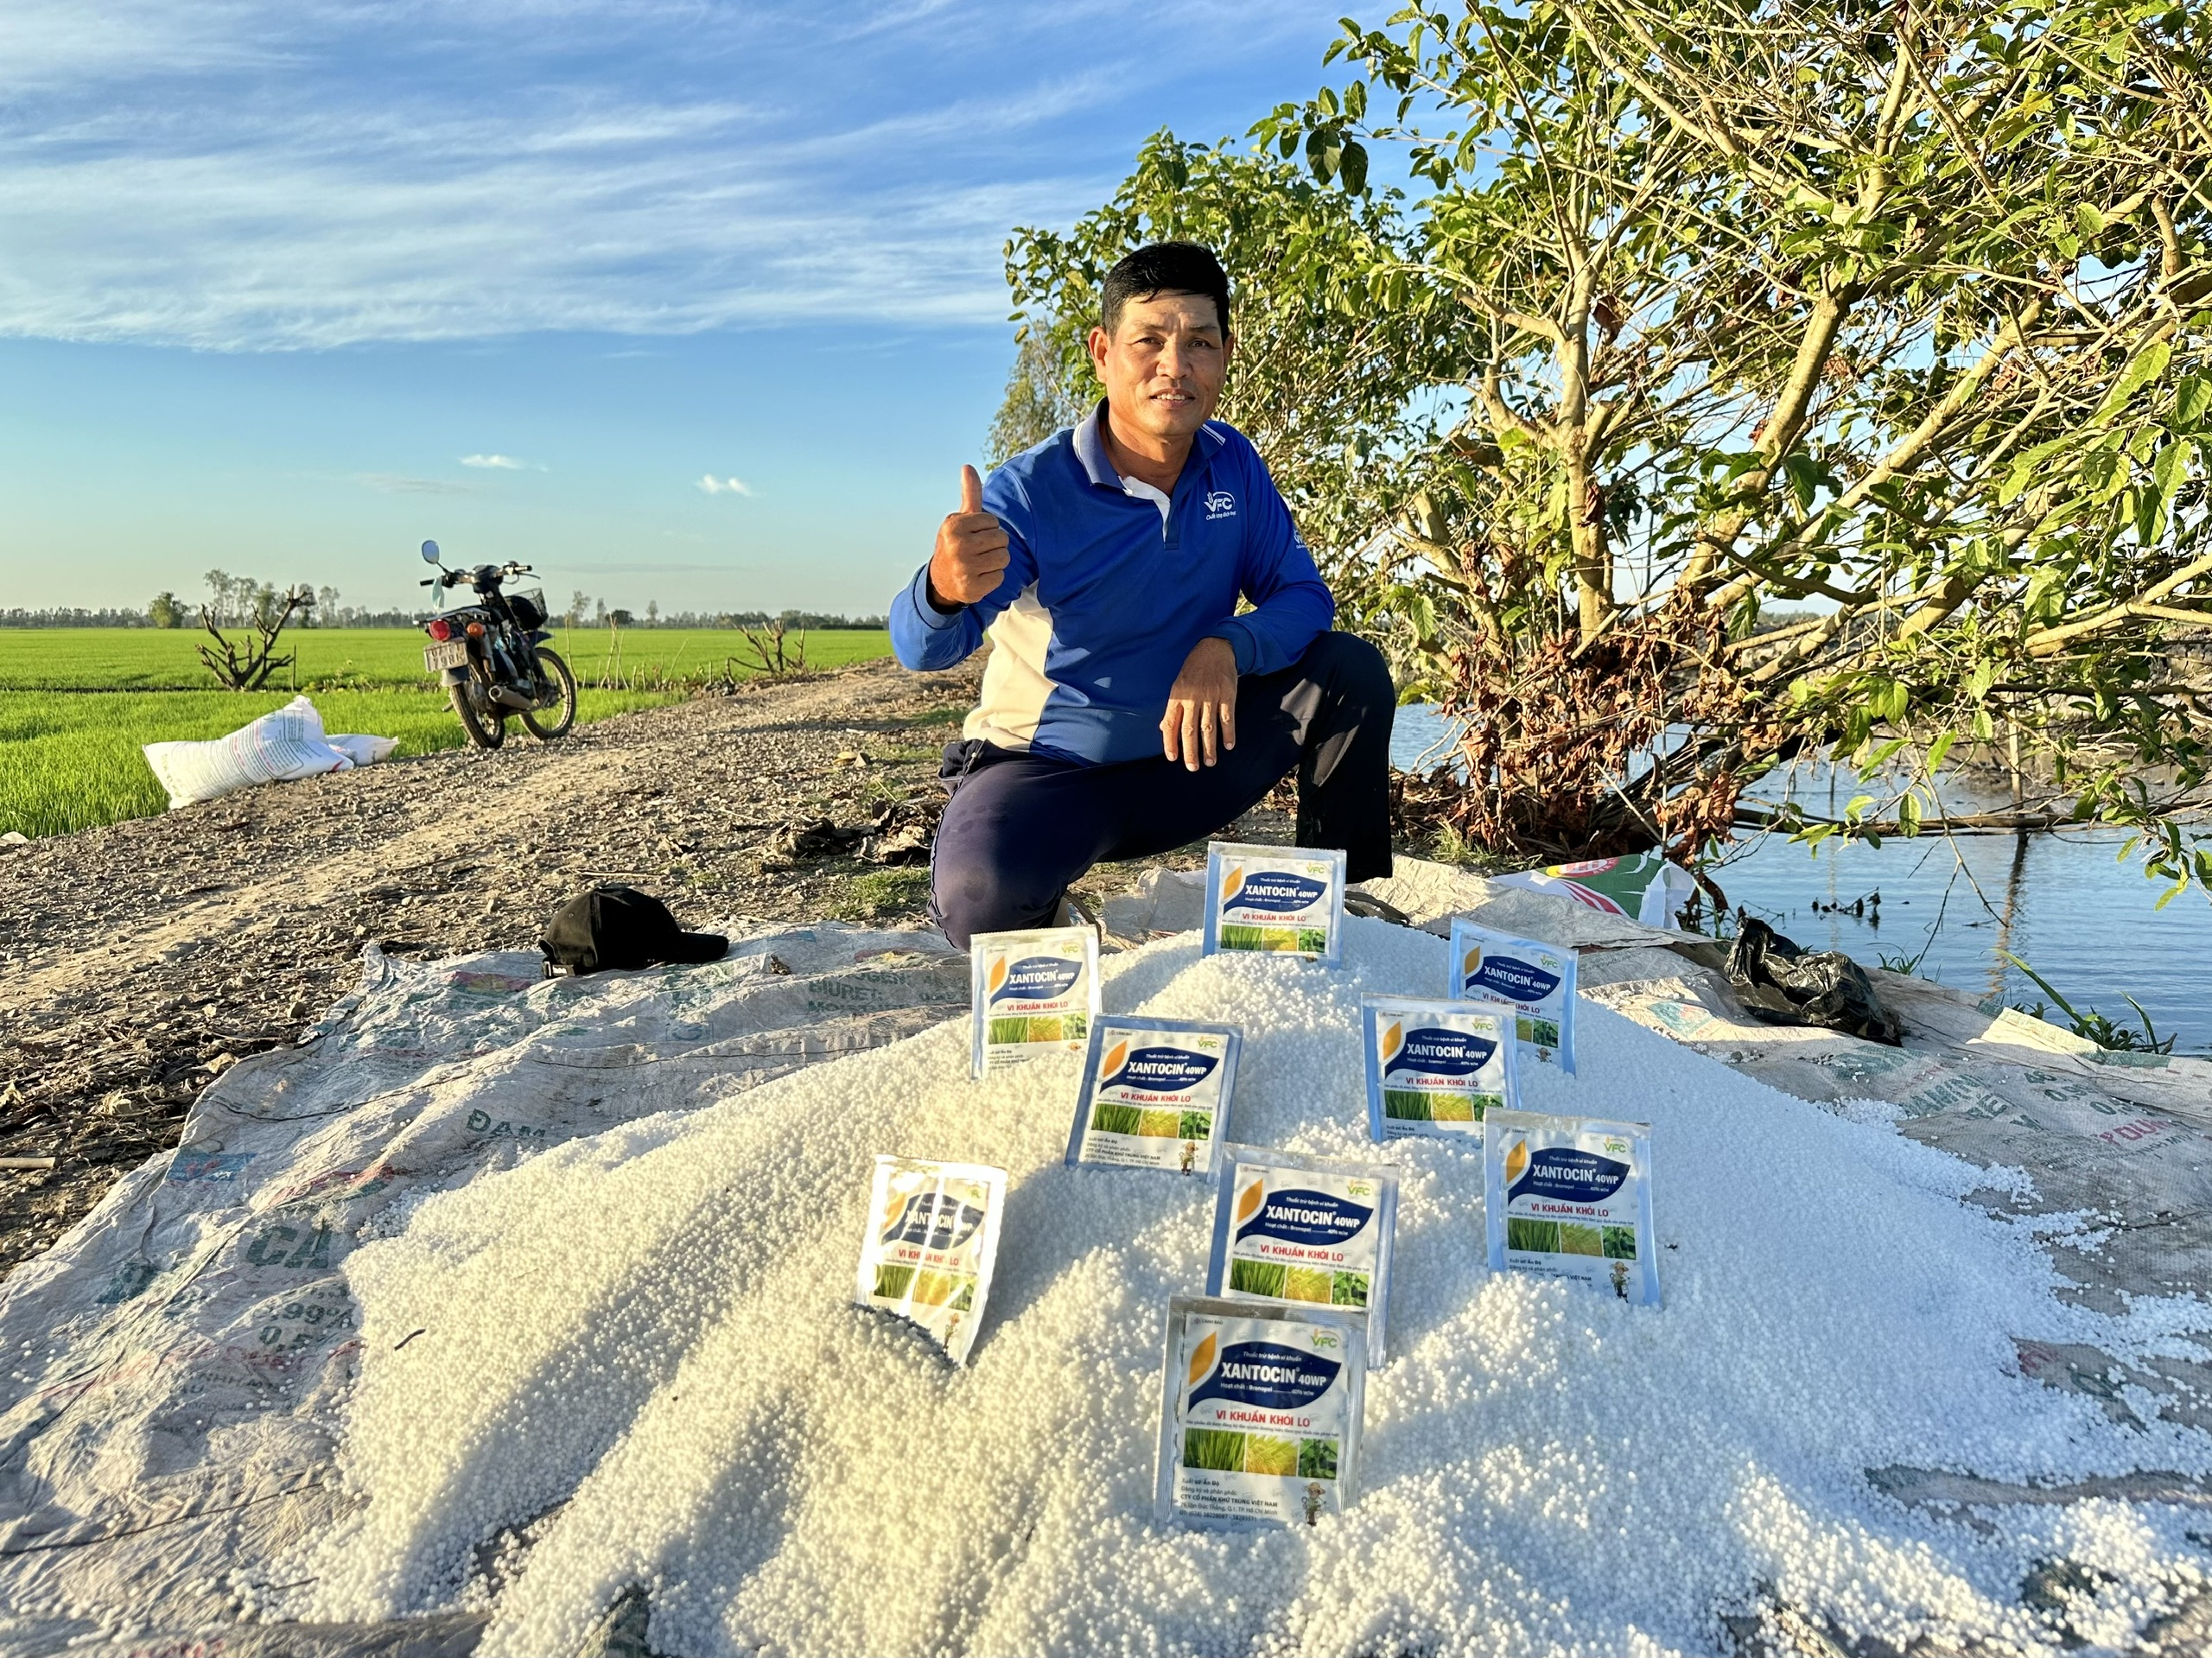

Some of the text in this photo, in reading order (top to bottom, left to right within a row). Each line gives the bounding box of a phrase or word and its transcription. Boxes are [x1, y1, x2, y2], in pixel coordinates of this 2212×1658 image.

[1204, 498, 1232, 511] VFC
[1541, 958, 1559, 969] VFC
[1532, 981, 1551, 990] 40WP
[1472, 1022, 1494, 1031] VFC
[1198, 1040, 1218, 1049] VFC
[1185, 1066, 1207, 1075] 40WP
[1604, 1143, 1626, 1153] VFC
[1595, 1175, 1618, 1185] 40WP
[1347, 1185, 1370, 1196] VFC
[1334, 1217, 1360, 1228] 40WP
[950, 1256, 959, 1266] LO
[1332, 1253, 1344, 1261] LO
[1311, 1336, 1338, 1348] VFC
[1298, 1375, 1326, 1386] 40WP
[1216, 1410, 1226, 1420] VI
[1298, 1417, 1310, 1427] LO
